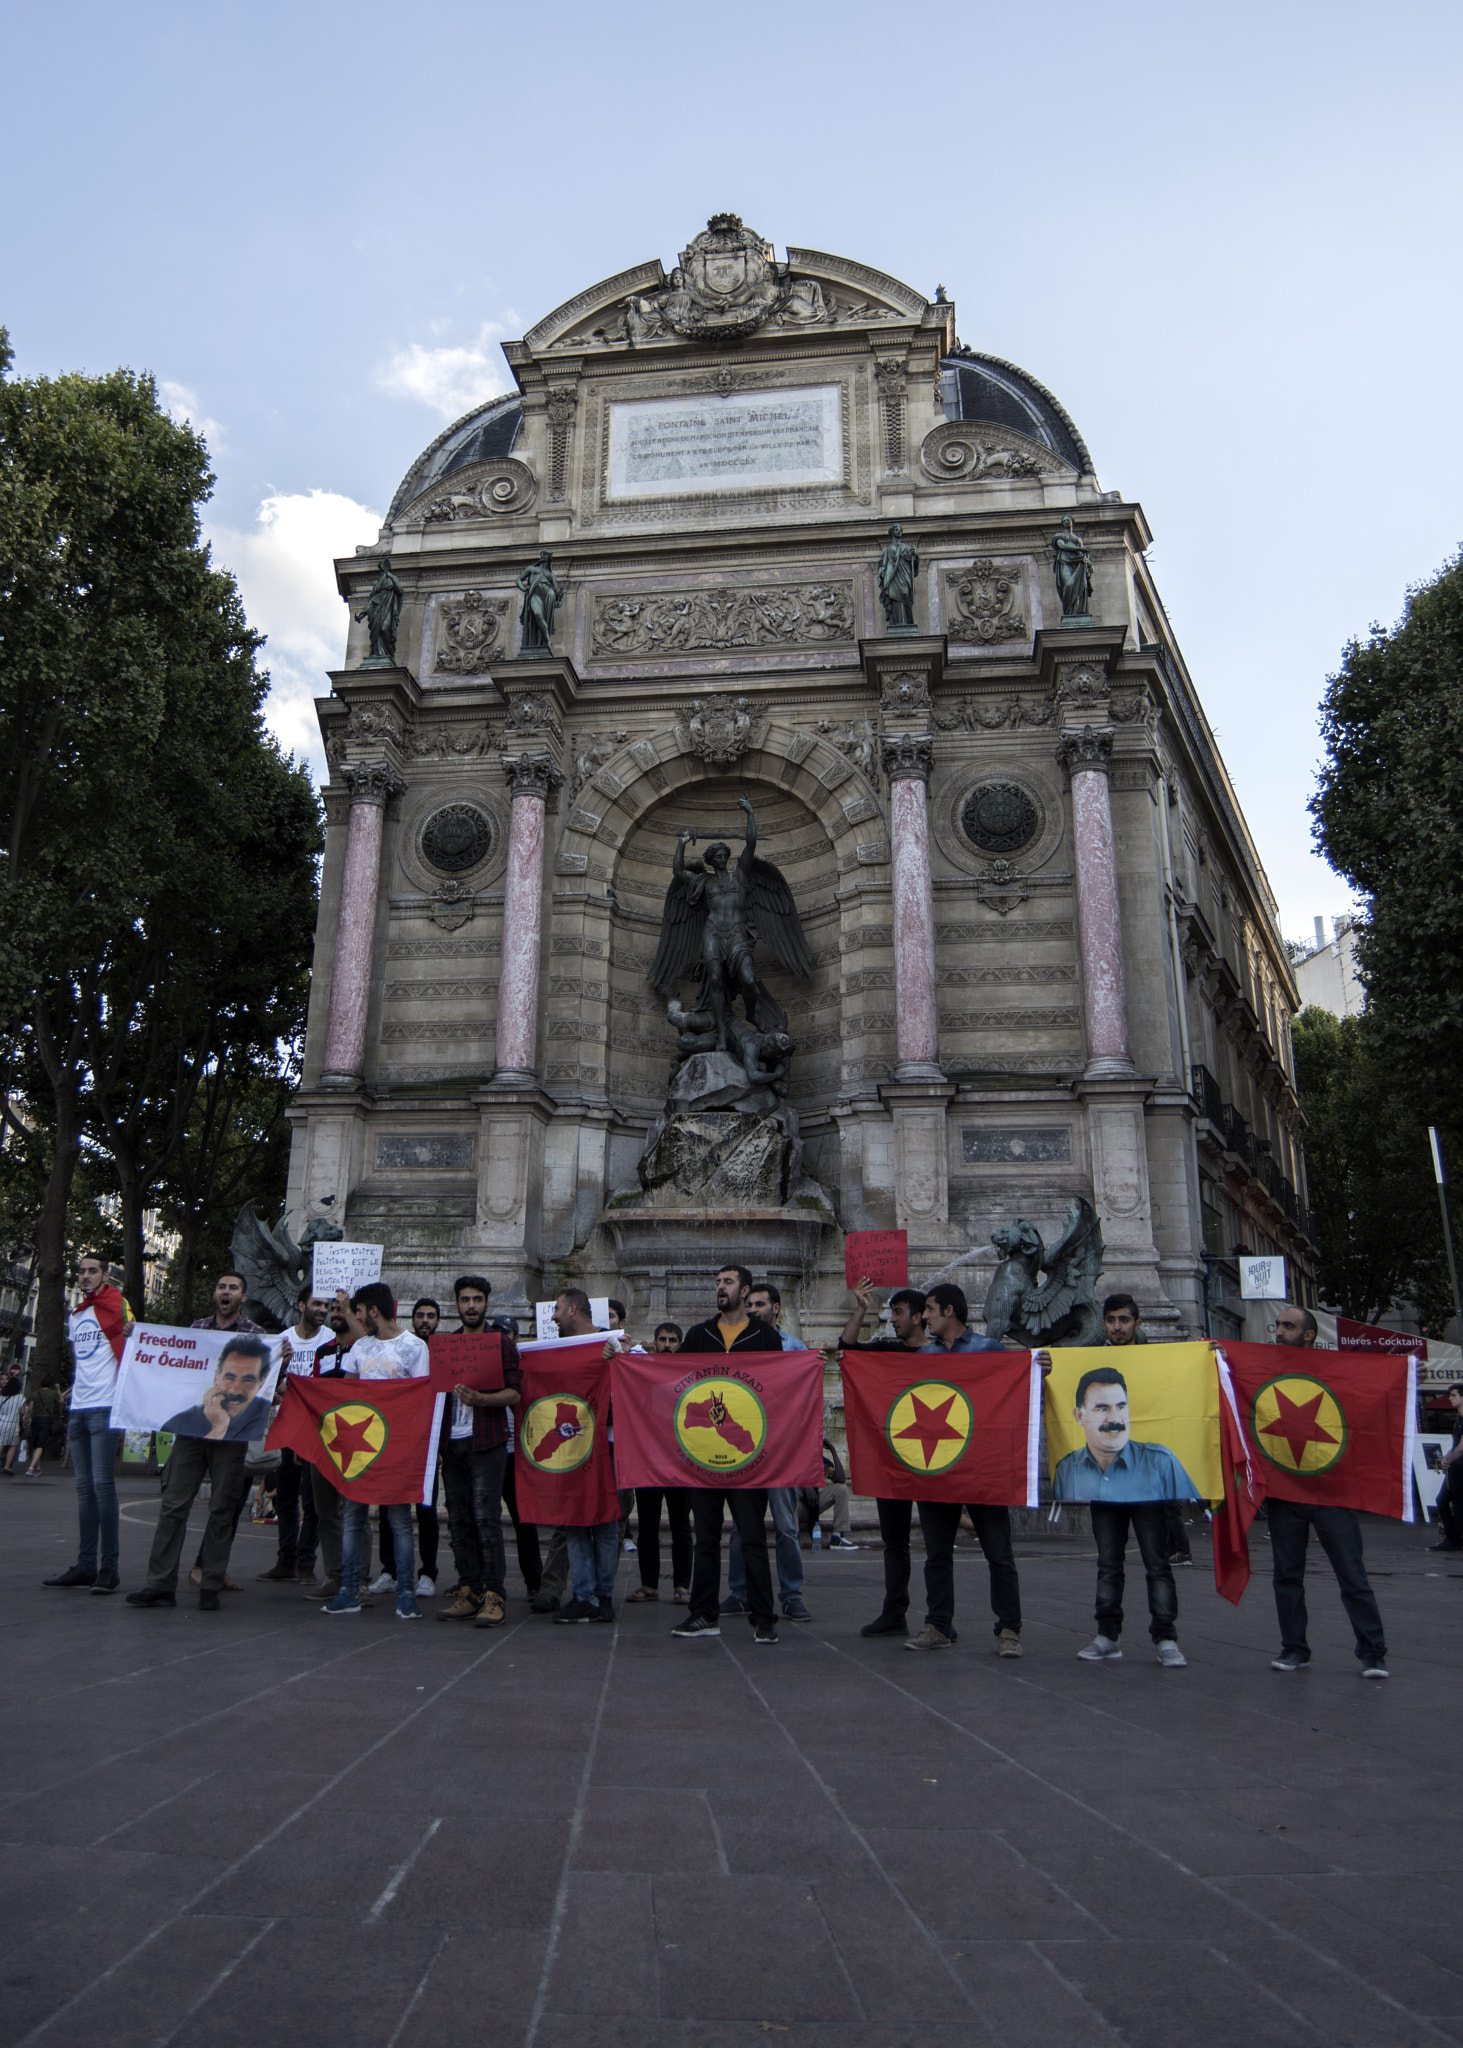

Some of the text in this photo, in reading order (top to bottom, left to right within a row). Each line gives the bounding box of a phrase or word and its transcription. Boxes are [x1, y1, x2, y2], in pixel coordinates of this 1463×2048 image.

[658, 412, 791, 430] FONTAINE SAINT MICHEL
[352, 1258, 369, 1266] EST
[370, 1258, 380, 1266] LE
[1248, 1260, 1266, 1277] JOUR
[354, 1268, 365, 1278] DE
[367, 1268, 379, 1277] LA
[1254, 1268, 1271, 1284] NUIT
[139, 1332, 197, 1350] Freedom
[1341, 1336, 1372, 1346] Bières
[1378, 1337, 1423, 1347] Cocktails
[135, 1349, 210, 1370] for Öcalan!
[733, 1370, 764, 1393] AZAD
[1427, 1369, 1463, 1380] ICHE
